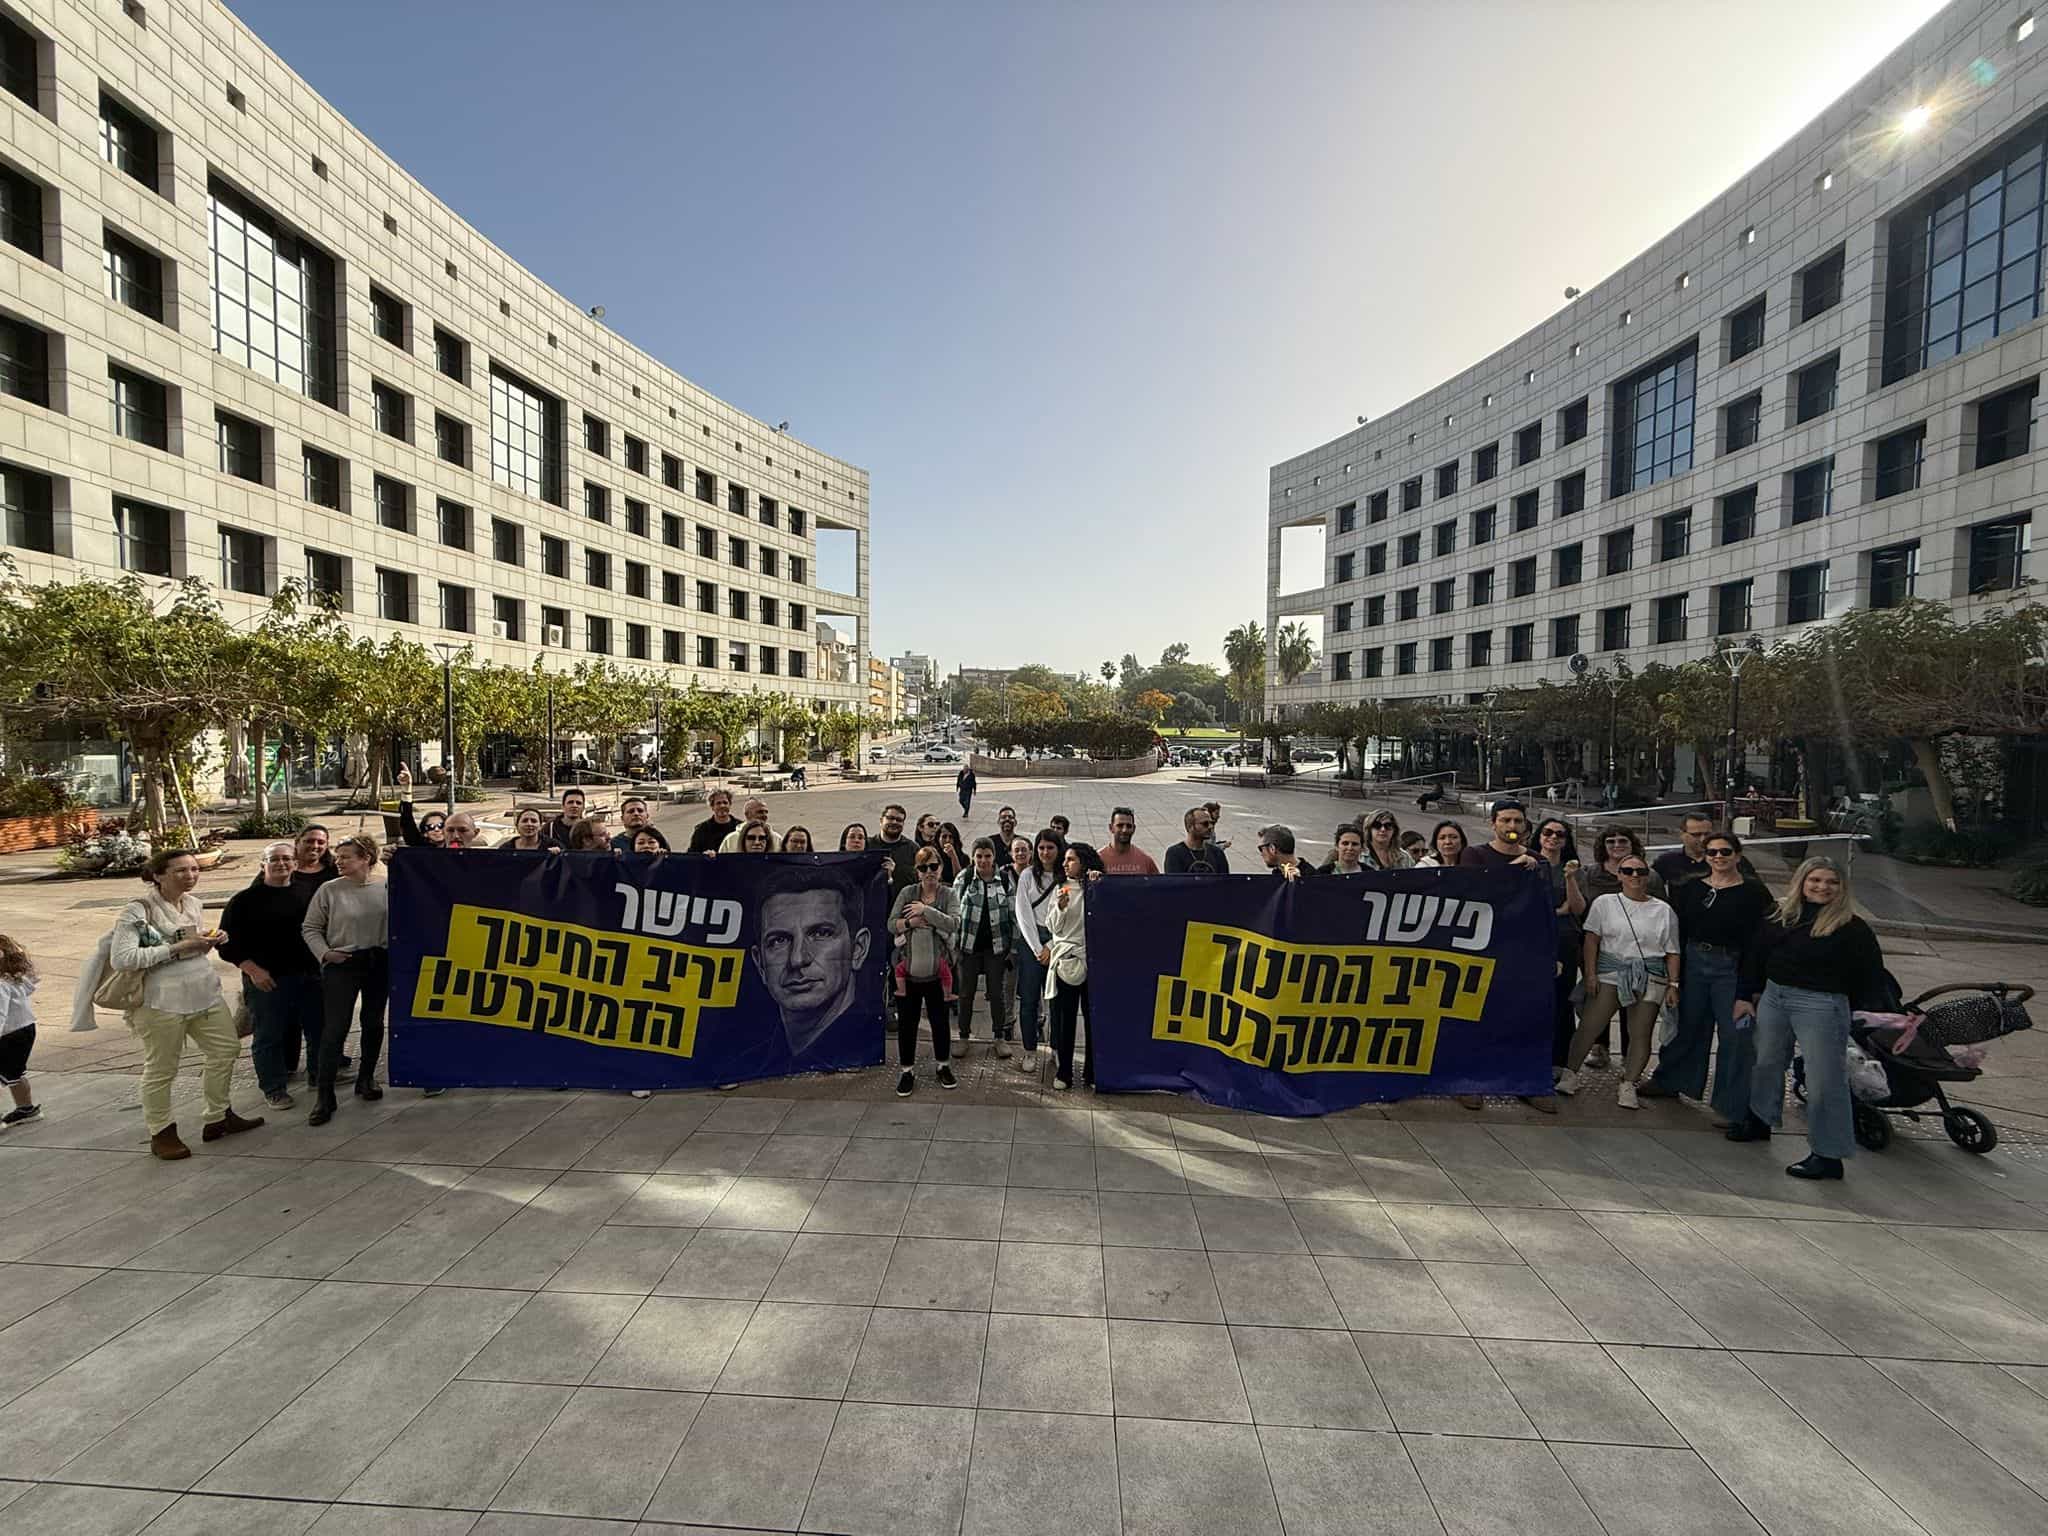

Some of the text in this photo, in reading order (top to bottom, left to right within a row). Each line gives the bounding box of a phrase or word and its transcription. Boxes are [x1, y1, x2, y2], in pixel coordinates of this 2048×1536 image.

[615, 882, 743, 944] פישר
[1362, 891, 1494, 950] פישר
[476, 915, 735, 1000] יריב החינוך
[1212, 933, 1483, 1009] יריב החינוך
[428, 960, 686, 1049] הדמוקרטי!
[1167, 979, 1424, 1071] הדמוקרטי!
